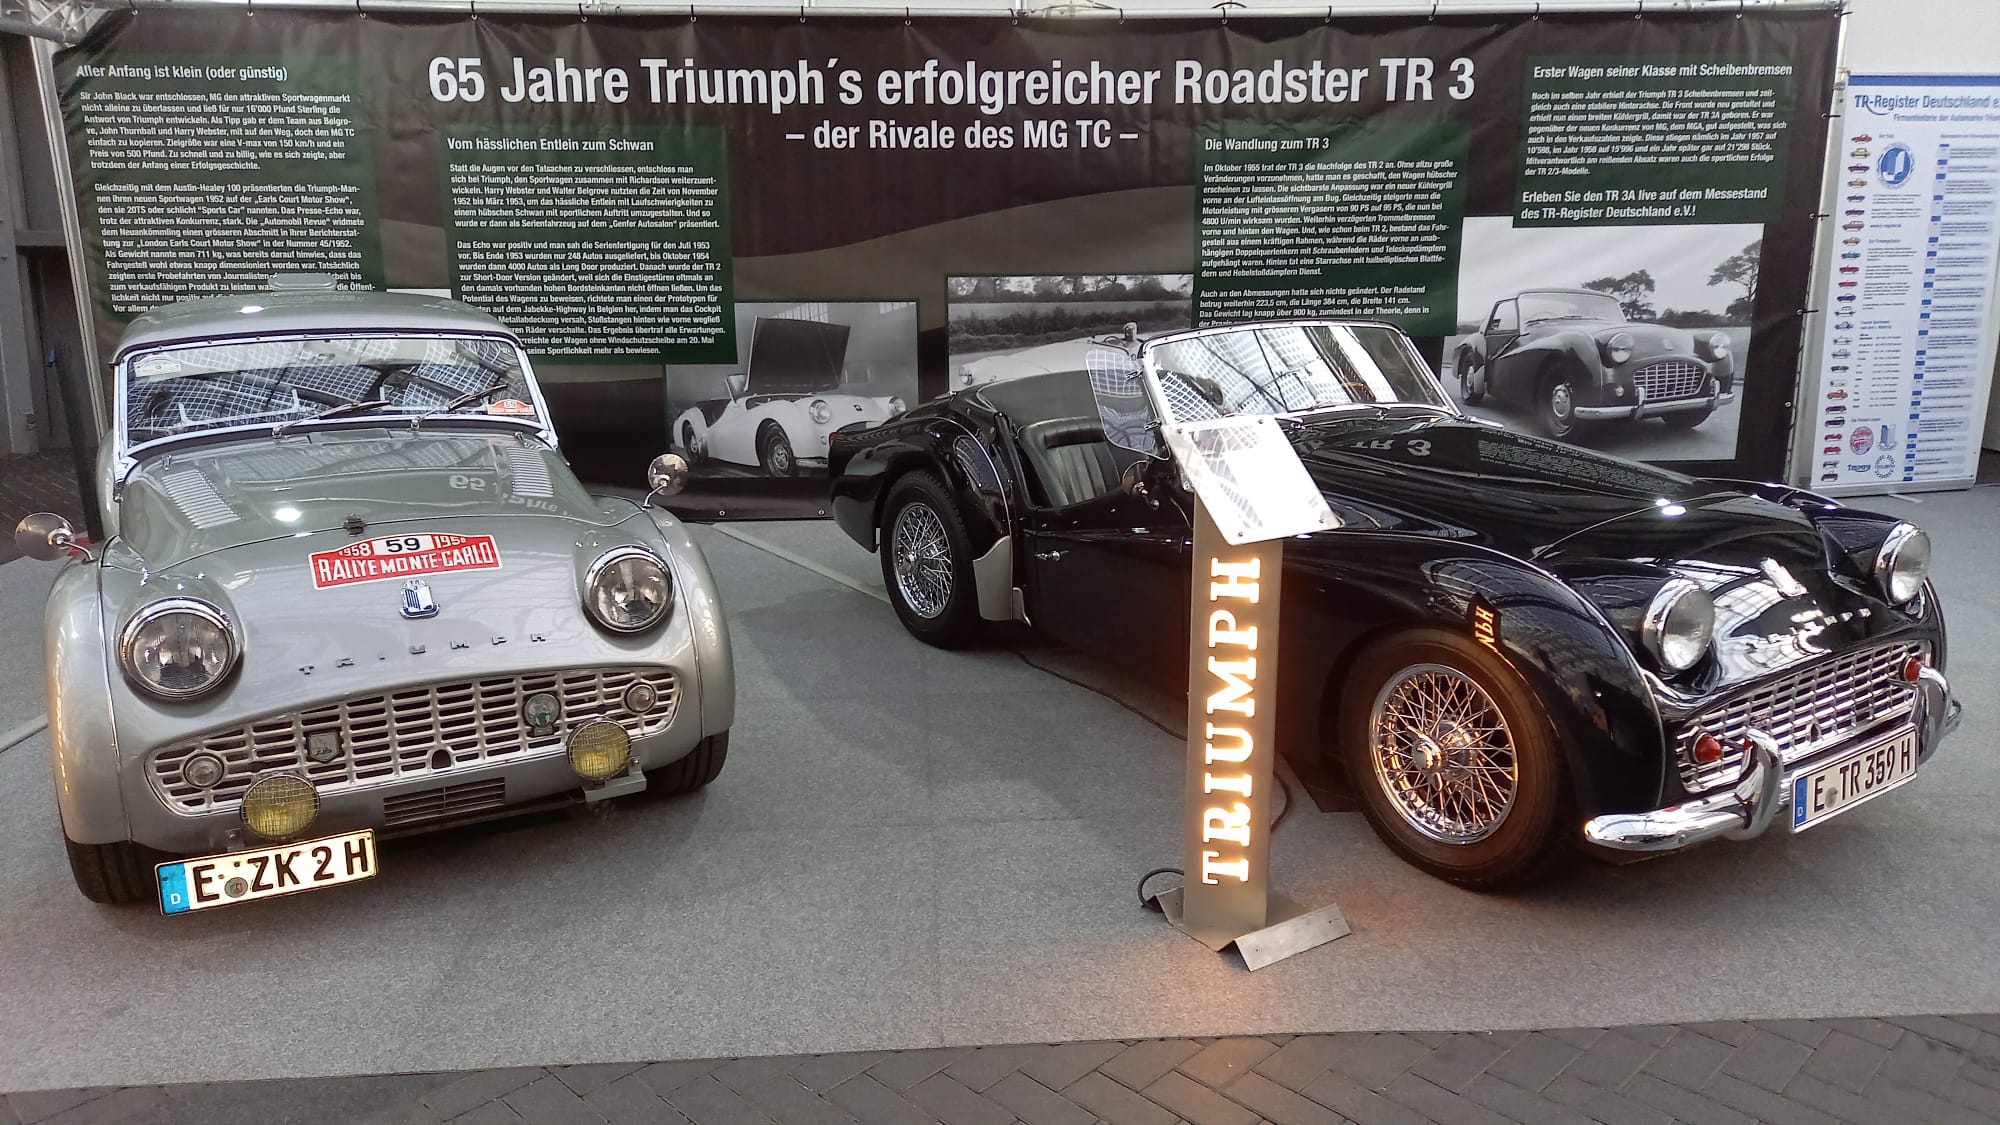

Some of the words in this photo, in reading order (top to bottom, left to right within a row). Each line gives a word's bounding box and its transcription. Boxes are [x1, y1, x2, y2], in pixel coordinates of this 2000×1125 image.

[75, 65, 105, 78] Aller
[108, 65, 151, 81] Anfang
[154, 66, 170, 78] ist
[172, 66, 202, 79] klein
[205, 66, 236, 82] (oder
[239, 67, 287, 82] günstig)
[1533, 66, 1566, 78] Erster
[1568, 66, 1603, 81] Wagen
[1606, 66, 1640, 78] seiner
[1641, 65, 1676, 77] Klasse
[1679, 65, 1697, 77] mit
[1699, 64, 1792, 77] Scheibenbremsen
[428, 59, 484, 102] 65
[500, 59, 628, 102] Jahre
[878, 57, 1160, 114] erfolgreicher
[1175, 57, 1368, 100] Roadster
[1380, 57, 1433, 100] TR
[1448, 57, 1474, 100] 3
[1923, 96, 1990, 108] Deutschland
[813, 120, 859, 149] der
[869, 120, 954, 149] Rivale
[964, 120, 1013, 149] des
[1023, 120, 1067, 149] MG
[1075, 120, 1110, 149] TC
[447, 138, 473, 150] Vom
[475, 138, 537, 150] hässlichen
[540, 138, 579, 151] Entlein
[582, 141, 606, 151] zum
[608, 139, 653, 151] Schwan
[1205, 139, 1222, 151] Die
[1224, 138, 1278, 153] Wandlung
[1280, 141, 1303, 150] zum
[1306, 138, 1319, 150] TR
[1322, 138, 1329, 150] 3
[89, 150, 109, 158] Preis
[126, 150, 141, 158] 500
[142, 150, 167, 159] Pfund.
[168, 150, 178, 159] Zu
[180, 150, 207, 159] schnell
[208, 150, 223, 159] und
[236, 151, 257, 161] billig,
[258, 151, 272, 159] wie
[284, 151, 300, 159] sich
[302, 151, 327, 161] zeigte,
[328, 151, 345, 160] aber
[90, 161, 126, 169] trotzdem
[127, 161, 140, 169] der
[141, 161, 169, 171] Anfang
[170, 161, 190, 170] einer
[191, 161, 260, 172] Erfolgsgeschichte.
[1522, 190, 1562, 203] Erleben
[1564, 190, 1581, 202] Sie
[1583, 190, 1602, 202] den
[1605, 190, 1619, 202] TR
[1621, 189, 1635, 202] 3A
[1638, 189, 1657, 201] live
[1659, 189, 1677, 201] auf
[1678, 188, 1702, 201] dem
[1704, 188, 1767, 200] Messestand
[453, 208, 476, 216] einem
[514, 209, 544, 217] Schwan
[545, 209, 558, 217] mit
[559, 209, 602, 218] sportlichem
[603, 209, 629, 217] Auftritt
[630, 209, 685, 219] umzugestalten.
[686, 209, 700, 217] Und
[1520, 208, 1540, 220] des
[1542, 207, 1604, 222] TR-Register
[1605, 206, 1671, 218] Deutschland
[1673, 205, 1696, 217] e.V.!
[472, 252, 484, 260] Bis
[485, 252, 504, 260] Ende
[505, 252, 523, 260] 1953
[524, 252, 552, 260] wurden
[567, 252, 581, 260] 248
[582, 252, 603, 260] Autos
[604, 252, 649, 262] ausgeliefert,
[650, 252, 661, 260] bis
[662, 252, 690, 260] Oktober
[692, 252, 709, 260] 1954
[106, 261, 147, 270] Fahrgestell
[148, 261, 168, 269] wohl
[168, 261, 192, 269] etwas
[193, 261, 217, 271] knapp
[218, 261, 270, 269] dimensioniert
[271, 261, 300, 269] worden
[1218, 269, 1232, 277] und
[1298, 268, 1322, 276] Dienst.
[473, 273, 513, 281] Short-Door
[513, 273, 541, 281] Version
[542, 273, 577, 283] geändert,
[577, 273, 593, 281] weil
[594, 273, 610, 281] sich
[611, 273, 622, 281] die
[675, 273, 703, 281] oftmals
[1255, 299, 1274, 308] 223,5
[1275, 300, 1288, 308] cm,
[1289, 298, 1300, 306] die
[1336, 299, 1349, 307] cm,
[1350, 297, 1361, 305] die
[386, 538, 421, 553] 59
[318, 558, 379, 582] RALLYE
[381, 541, 494, 574] MONTE-CARLO
[299, 633, 546, 675] TRIUMPH
[1202, 557, 1261, 886] TRIUMPH
[1814, 776, 1825, 813] E
[1839, 760, 1859, 801] TR
[1865, 745, 1895, 788] 359
[1900, 737, 1911, 774] H
[193, 864, 220, 902] E
[248, 851, 301, 893] ZK
[312, 847, 335, 881] 2
[345, 838, 369, 875] H
[171, 894, 181, 904] D
